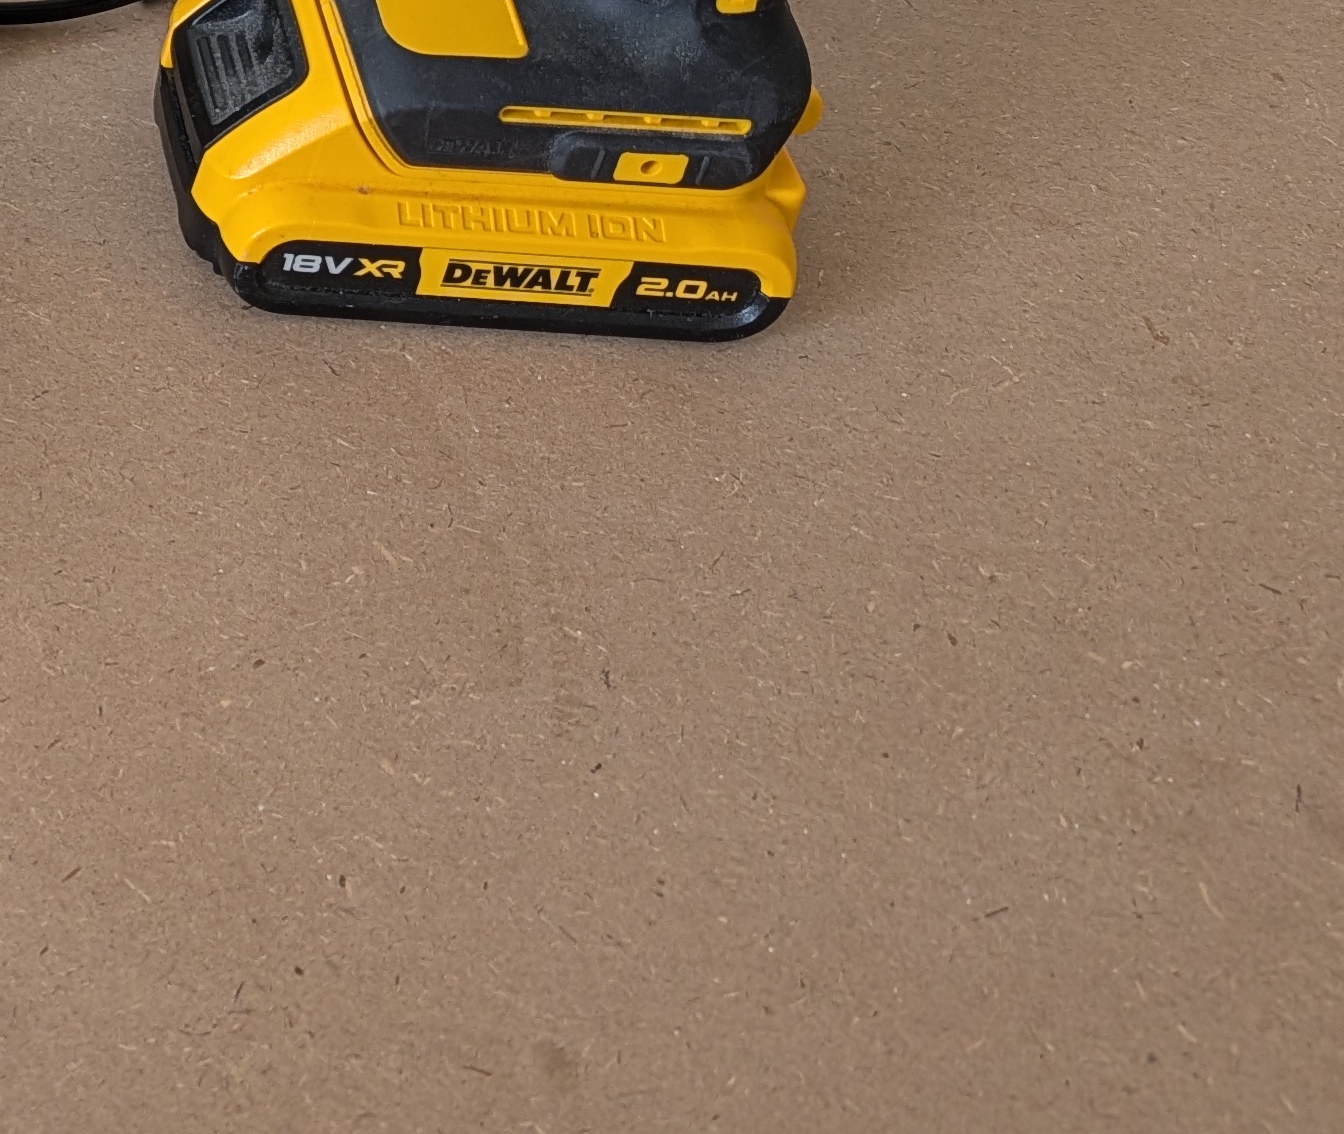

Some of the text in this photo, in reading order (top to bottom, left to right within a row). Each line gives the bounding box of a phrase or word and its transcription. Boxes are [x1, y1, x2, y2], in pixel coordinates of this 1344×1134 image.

[397, 202, 666, 243] LITHIUM ION
[282, 253, 356, 276] 18V
[357, 259, 406, 279] XR
[442, 263, 598, 295] DEWALT
